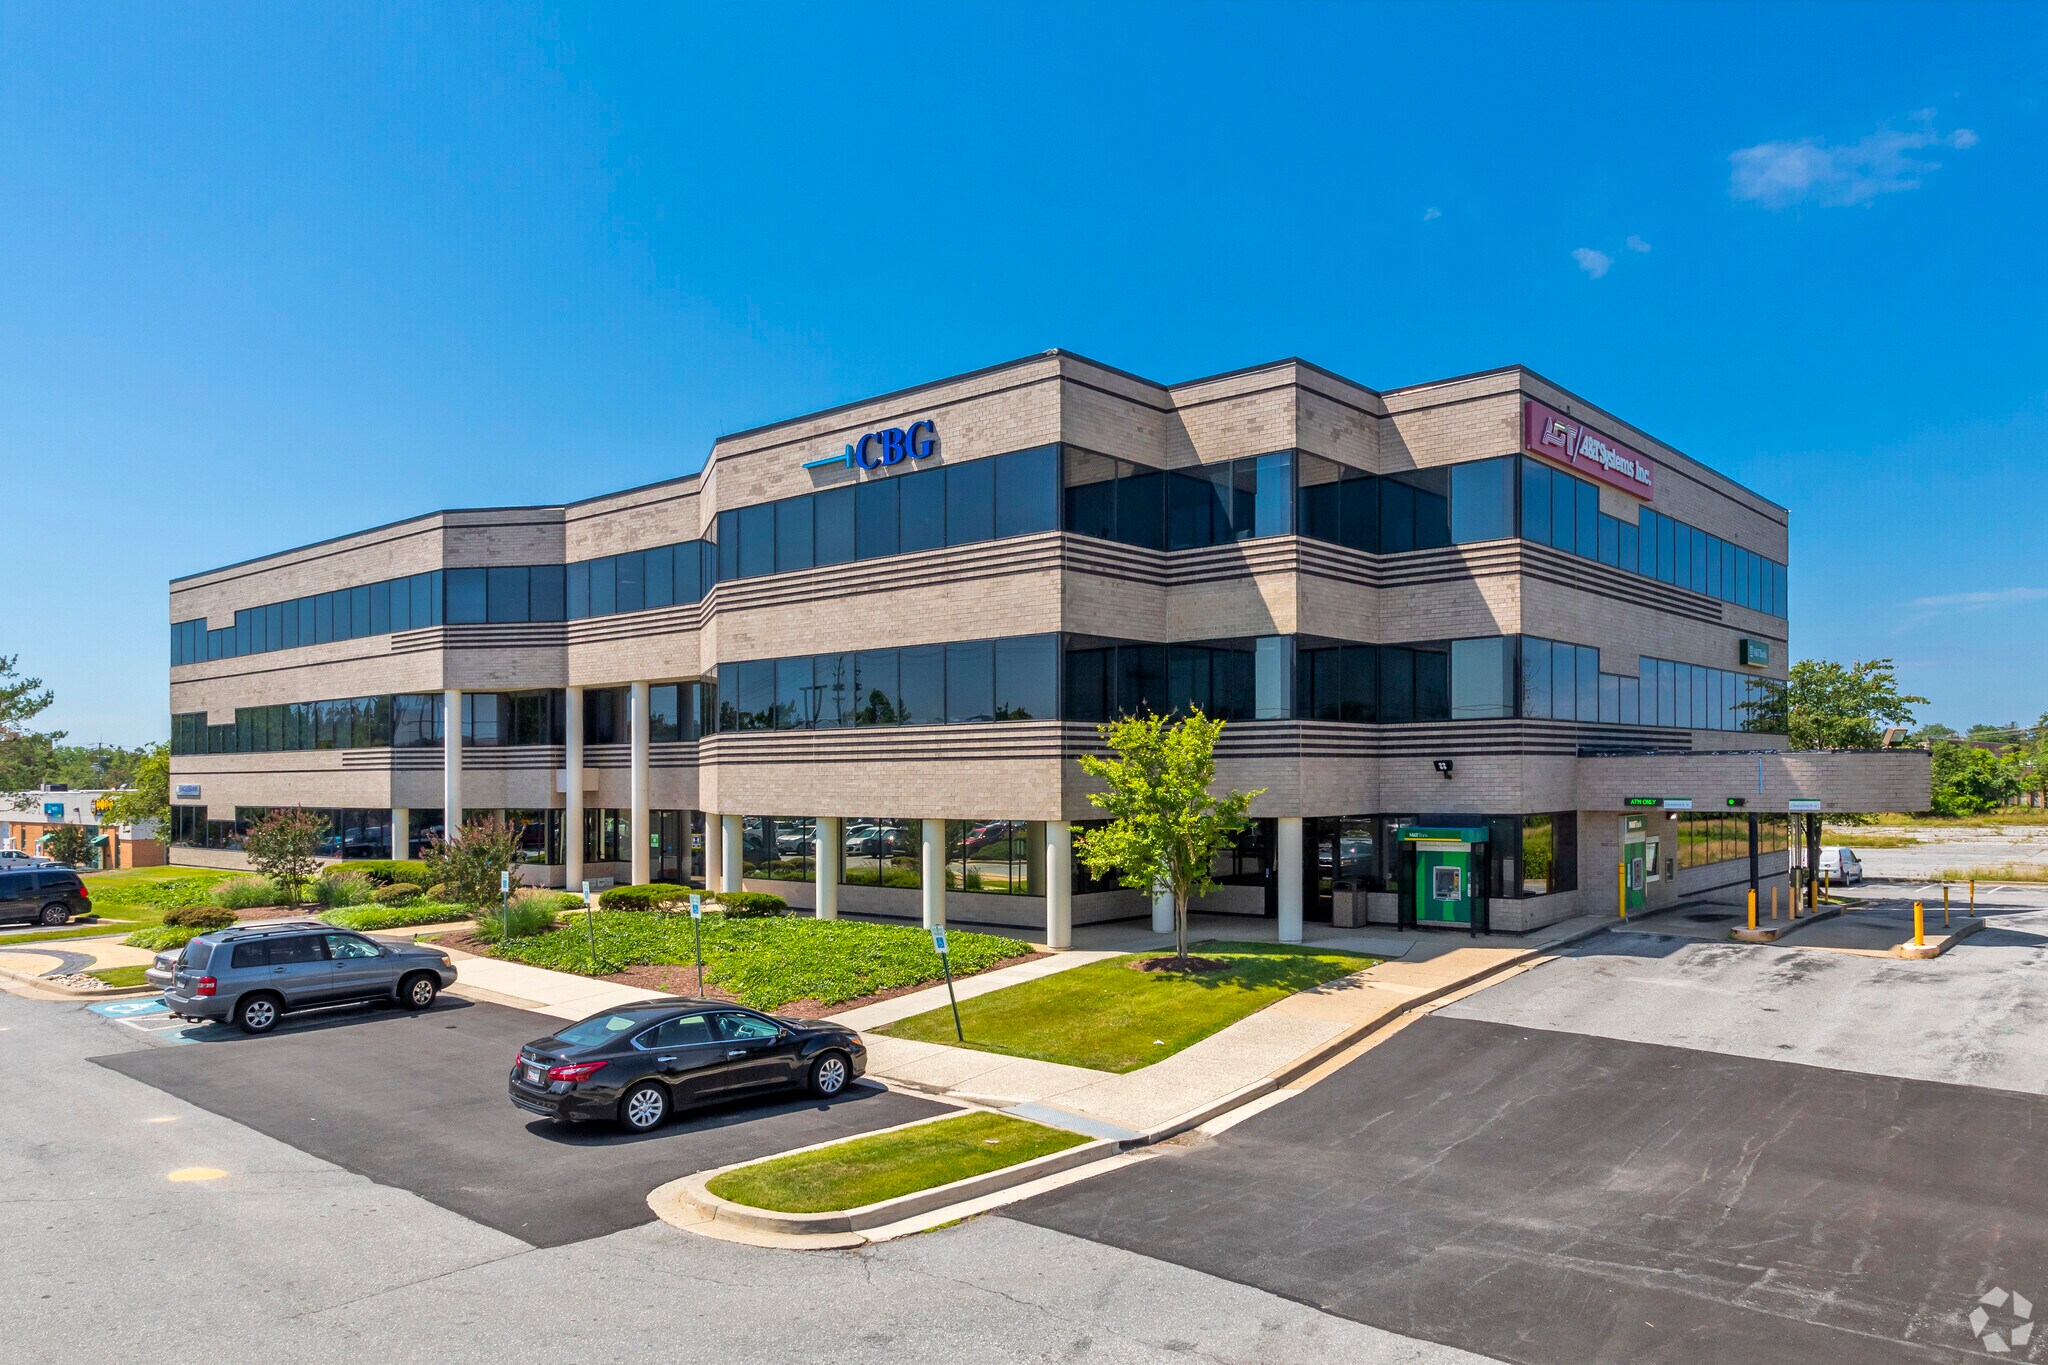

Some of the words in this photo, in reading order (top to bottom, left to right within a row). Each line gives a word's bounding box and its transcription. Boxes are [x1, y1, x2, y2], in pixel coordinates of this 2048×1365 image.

[855, 419, 936, 470] CBG
[1579, 435, 1601, 462] A&T
[1600, 443, 1635, 478] Systems
[1635, 460, 1652, 486] Inc.
